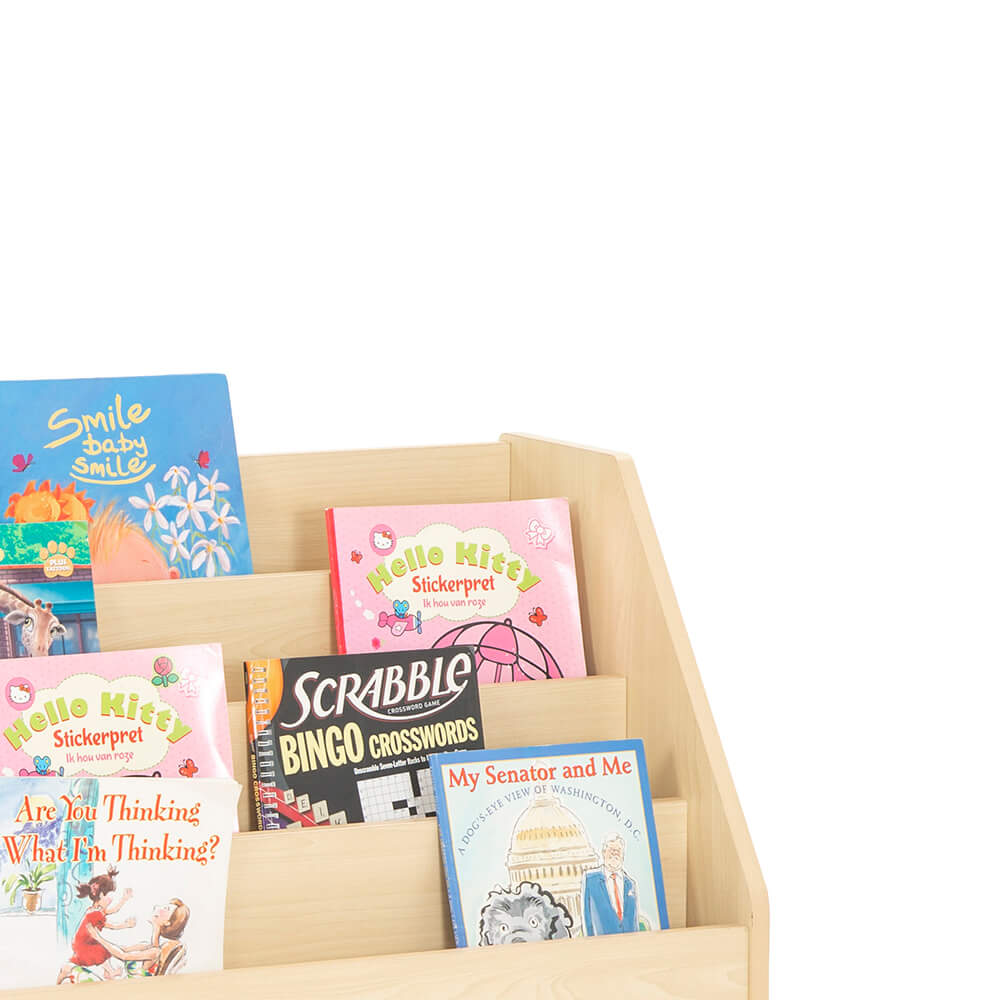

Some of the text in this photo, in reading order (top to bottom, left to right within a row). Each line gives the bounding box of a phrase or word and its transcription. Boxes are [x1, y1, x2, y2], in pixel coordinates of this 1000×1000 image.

[44, 393, 151, 449] Smile
[83, 432, 148, 458] baby
[71, 455, 147, 478] smile
[366, 542, 542, 594] Hello Kitty
[412, 575, 495, 598] Stickerpret
[423, 599, 431, 608] Ik
[432, 599, 449, 608] hou
[467, 599, 487, 609] roze
[3, 692, 192, 751] Hello Kitty
[387, 700, 441, 715] CROSSWORD GAME
[53, 726, 143, 750] Stickerpret
[279, 717, 479, 776] BINGO CROSSWORDS
[66, 751, 134, 763] Ik hou van roze
[448, 756, 632, 792] My Senator and Me
[15, 794, 201, 827] Are You Thinking
[459, 847, 466, 856] A
[504, 787, 531, 803] VIEW
[534, 785, 547, 794] OF
[551, 784, 622, 823] WASHINGTON,
[624, 819, 641, 841] D.C.
[2, 833, 220, 865] What I'm Thinking?
